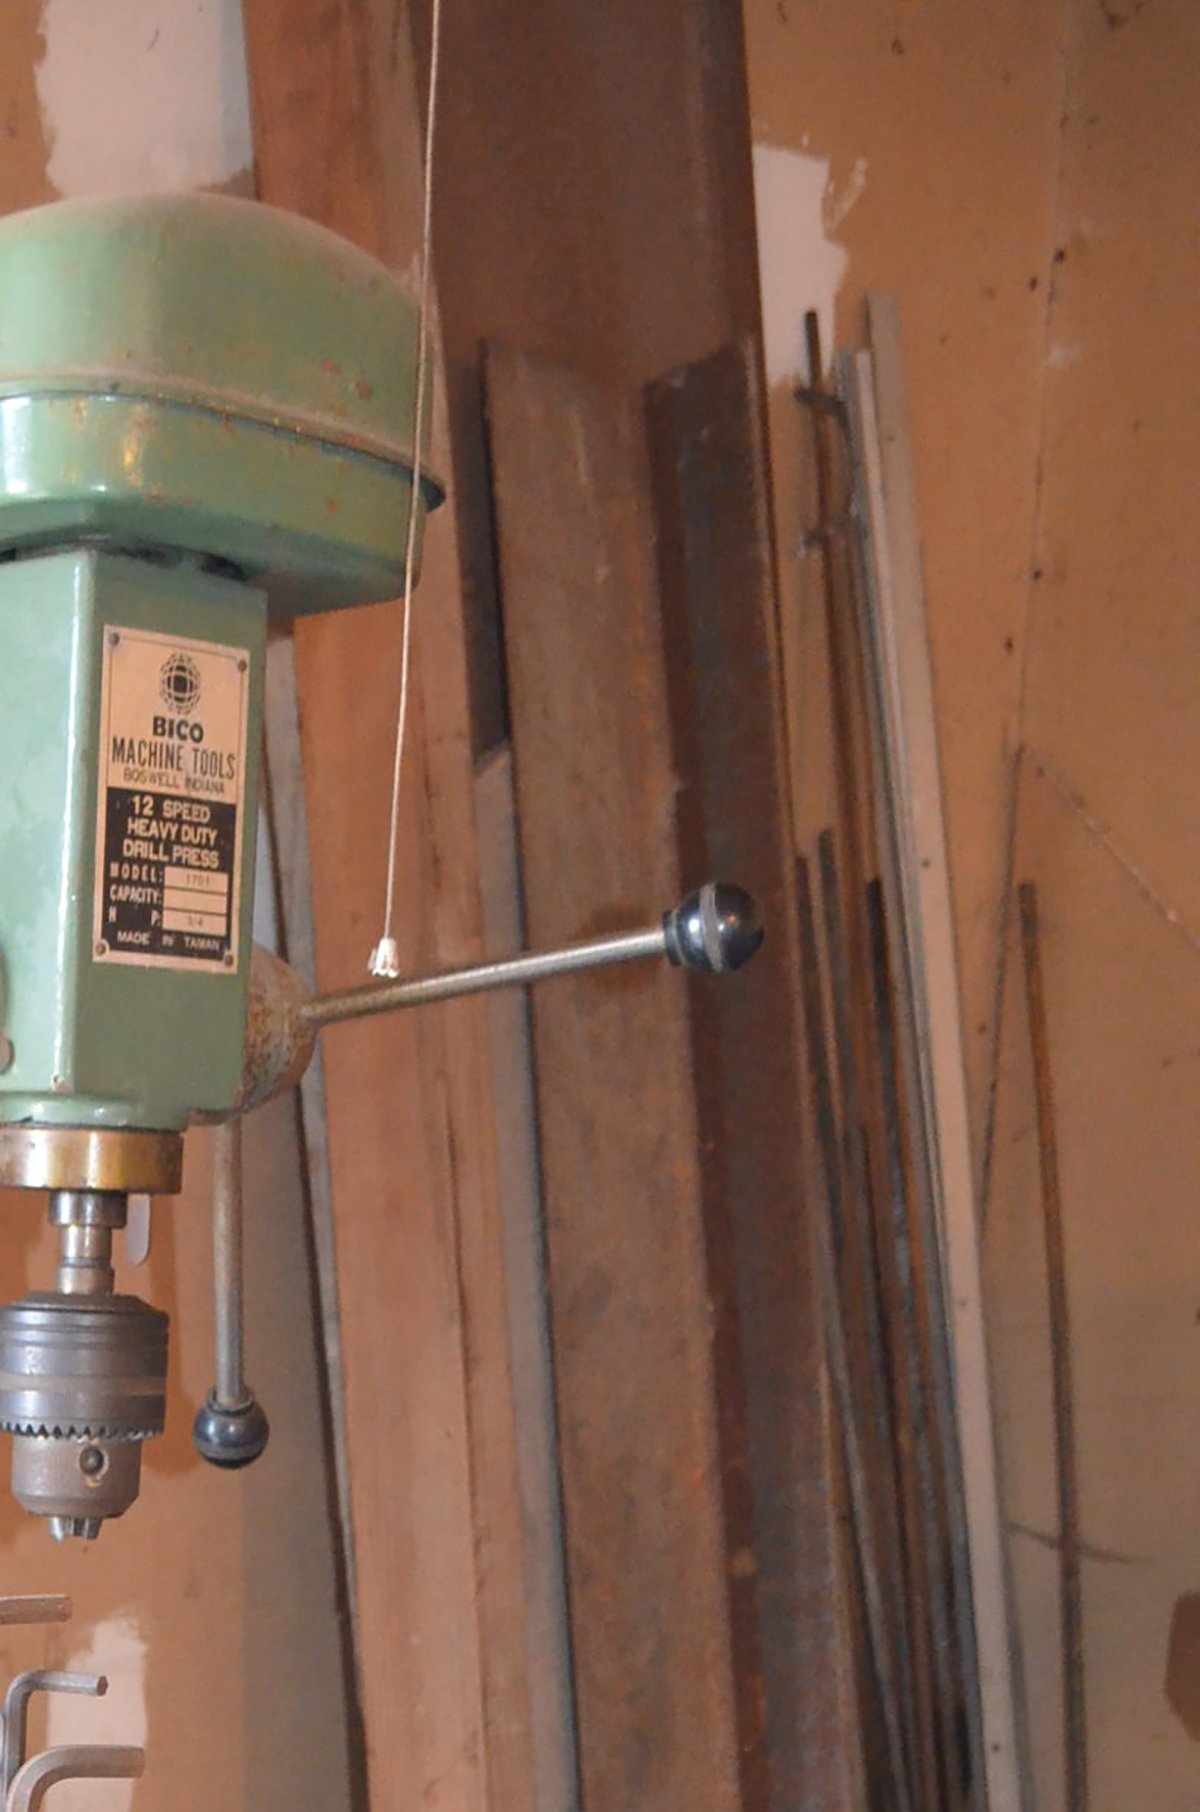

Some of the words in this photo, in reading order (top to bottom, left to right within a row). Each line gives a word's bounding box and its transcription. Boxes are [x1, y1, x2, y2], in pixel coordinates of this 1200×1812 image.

[153, 716, 204, 743] BICO
[112, 736, 183, 772] MACHINE
[192, 747, 236, 779] TOOLS
[123, 767, 180, 789] BOSWELL
[184, 777, 224, 793] INDIANA
[132, 794, 154, 816] 12
[162, 799, 211, 824] SPEED
[127, 817, 179, 841] HEAVY
[181, 824, 218, 847] DUTY
[123, 839, 169, 861] DRILL
[172, 844, 219, 869] PRESS
[117, 931, 150, 945] MADE
[183, 936, 220, 951] TAIWAN
